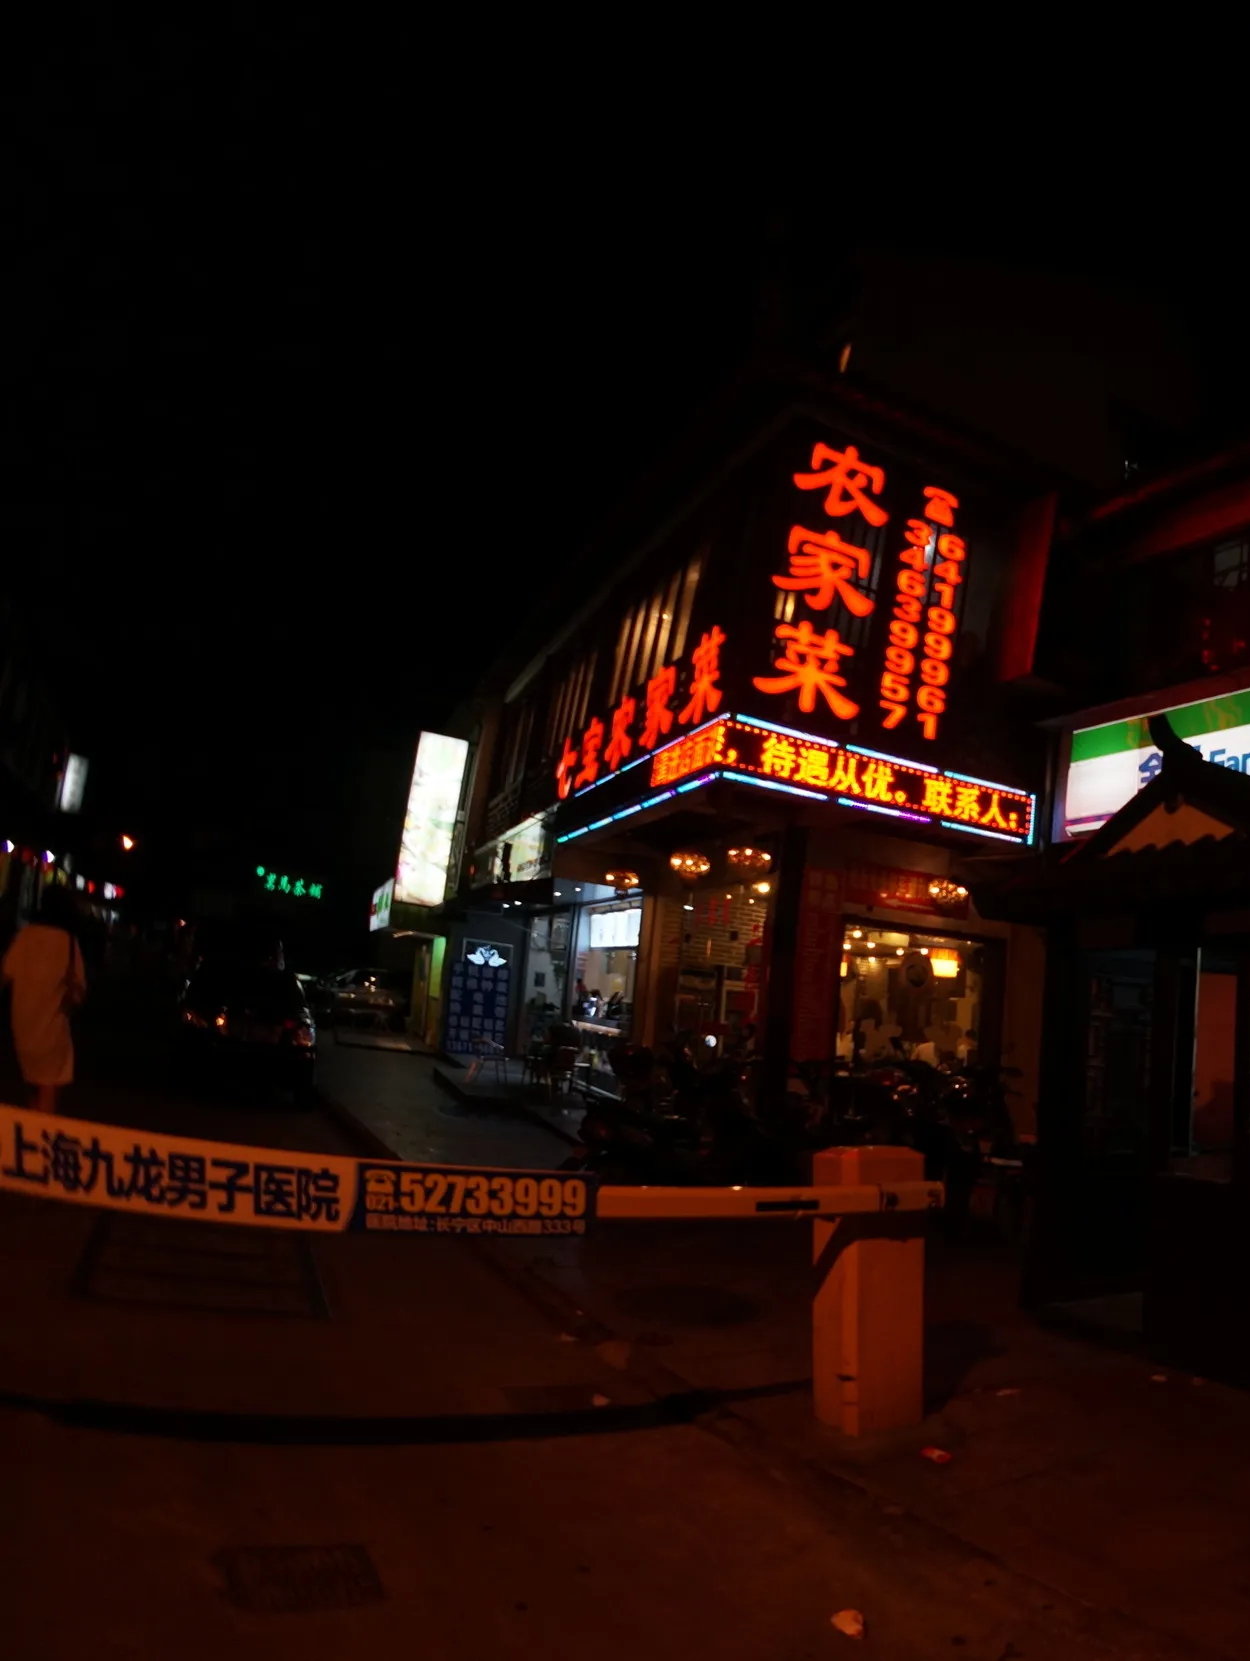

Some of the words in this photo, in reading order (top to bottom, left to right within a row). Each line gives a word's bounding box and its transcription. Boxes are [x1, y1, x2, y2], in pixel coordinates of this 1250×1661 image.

[753, 442, 889, 719] 农家菜
[880, 519, 932, 729] 34639957
[916, 533, 965, 740] 64199961
[556, 625, 727, 799] 七宝农家菜
[3, 1122, 341, 1222] 上海九龙男子医院
[401, 1172, 586, 1218] 52733999
